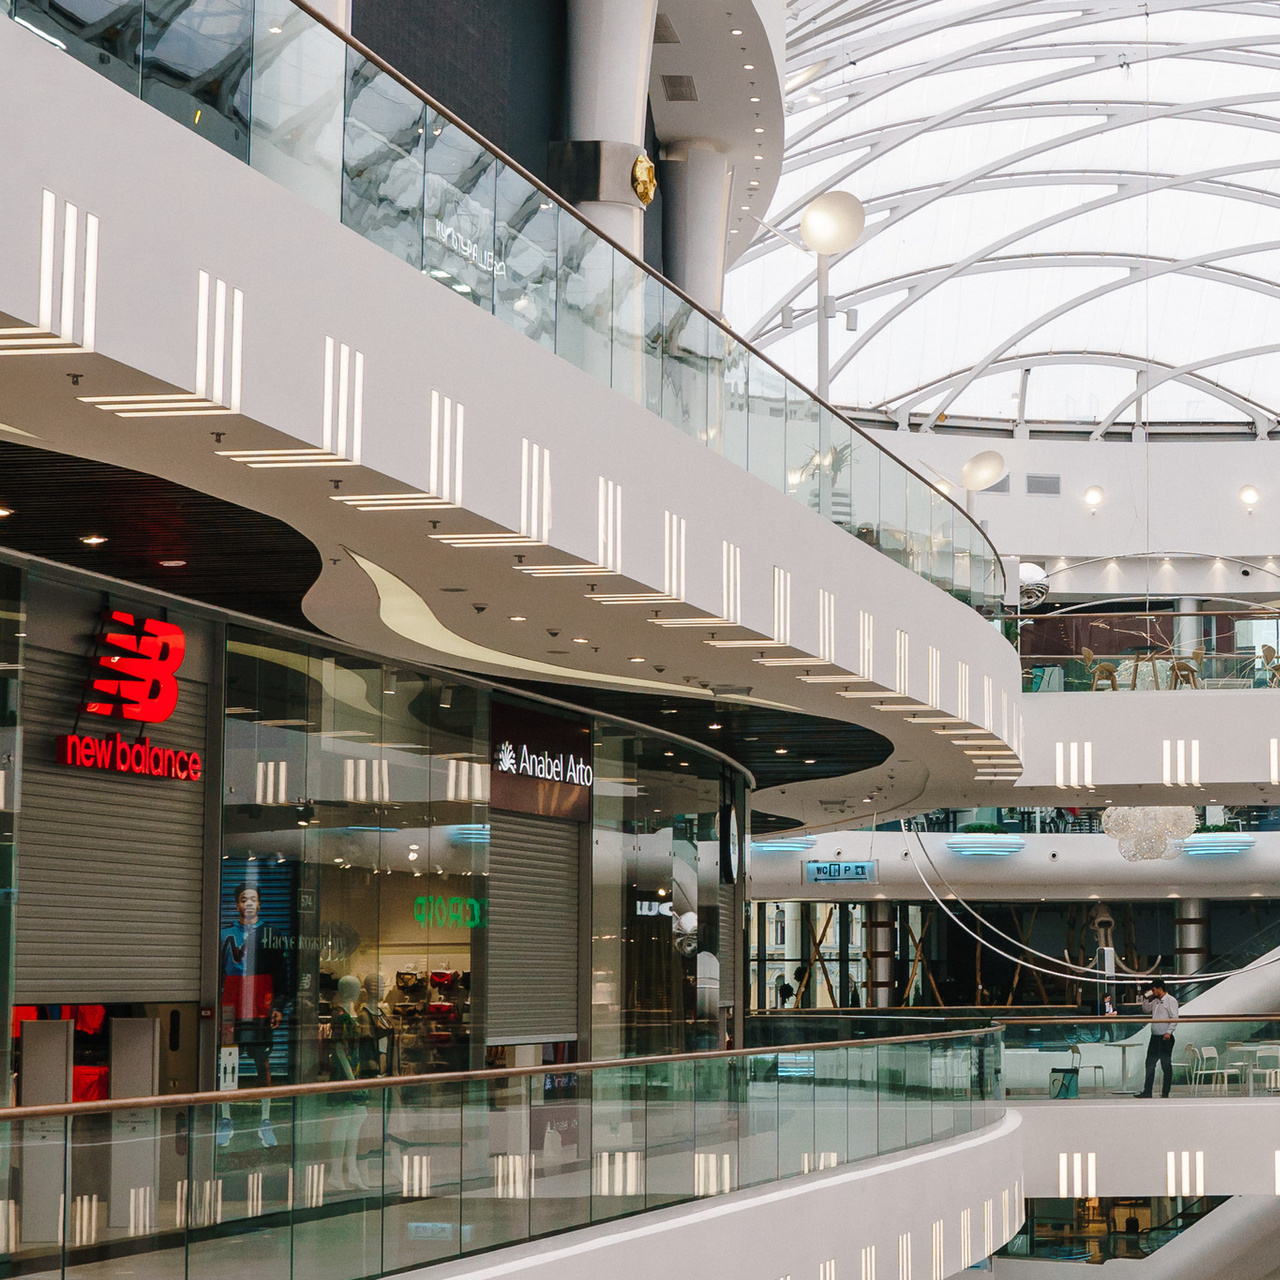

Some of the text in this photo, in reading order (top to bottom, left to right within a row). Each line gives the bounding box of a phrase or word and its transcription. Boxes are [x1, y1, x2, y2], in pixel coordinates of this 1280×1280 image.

[66, 732, 202, 782] new balance
[519, 743, 593, 787] Anabel Arto
[816, 866, 851, 875] WC P
